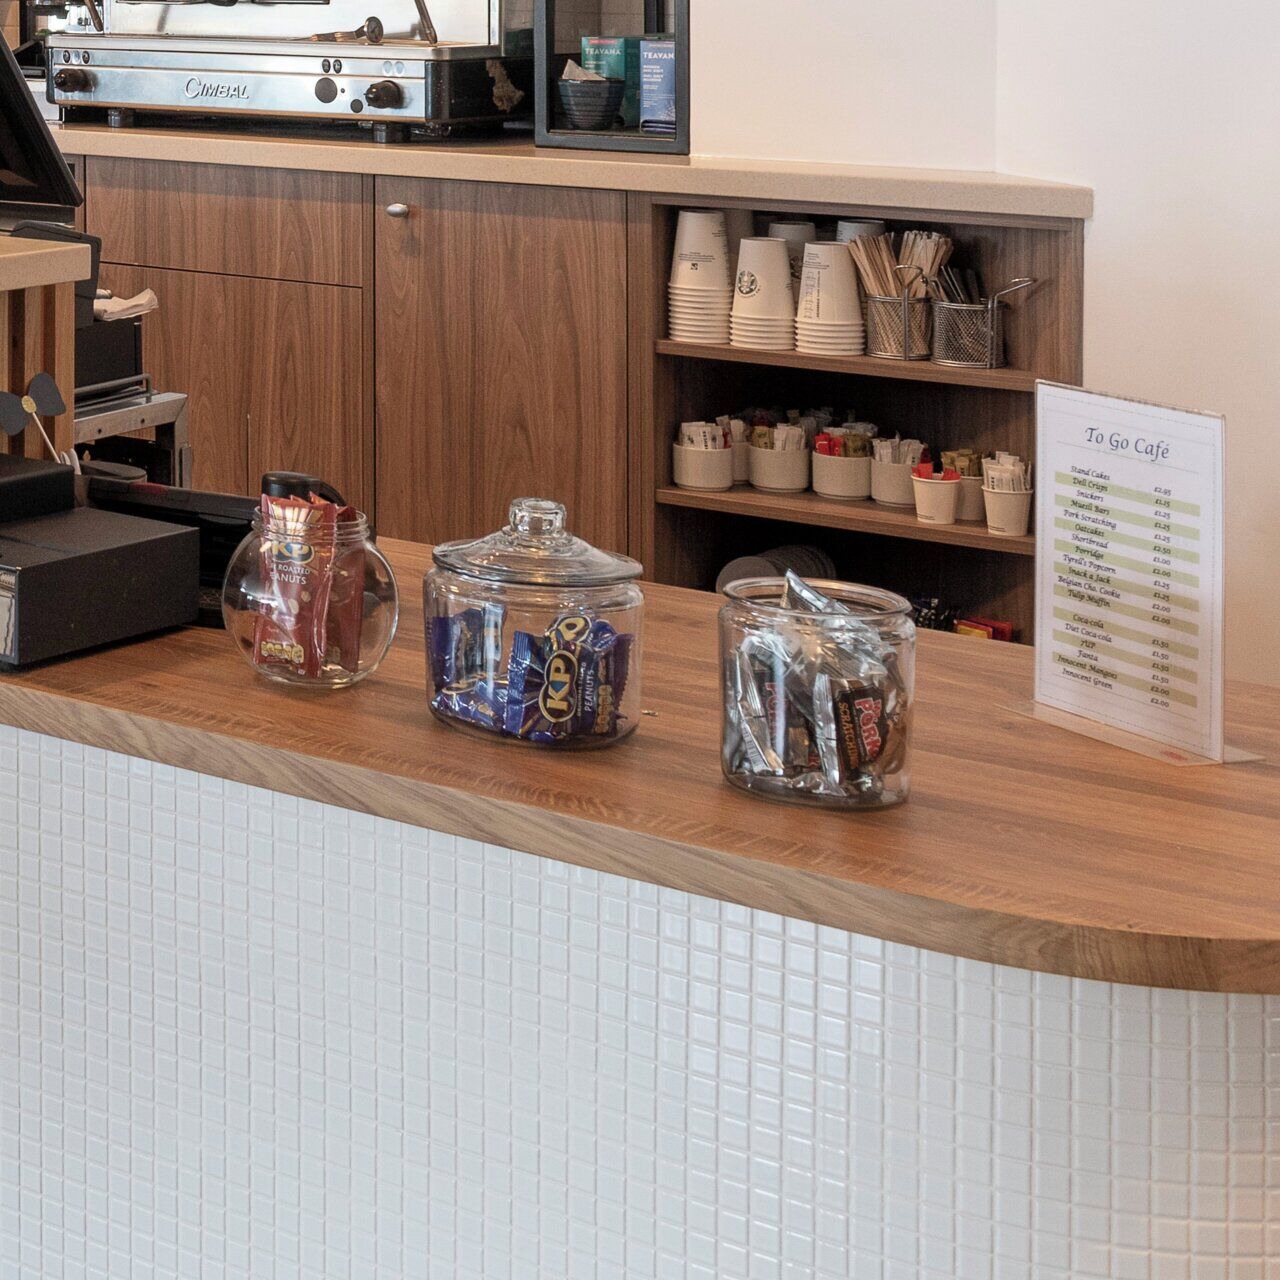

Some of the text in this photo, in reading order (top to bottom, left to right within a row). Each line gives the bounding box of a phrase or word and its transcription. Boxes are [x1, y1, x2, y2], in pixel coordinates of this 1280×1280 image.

[642, 52, 674, 60] TEAVAN
[1085, 427, 1170, 462] To Go Café
[1076, 490, 1104, 502] Snickers
[1094, 505, 1110, 515] Bars
[1074, 524, 1105, 537] Oatcakes
[1072, 533, 1110, 549] Shortbread
[272, 542, 310, 559] KP
[1088, 561, 1117, 574] Popcorn
[1081, 628, 1112, 642] Coca-cola
[1077, 650, 1098, 661] Fanta
[546, 657, 571, 712] KP
[1093, 678, 1112, 690] Green
[584, 670, 595, 712] PEANUTS
